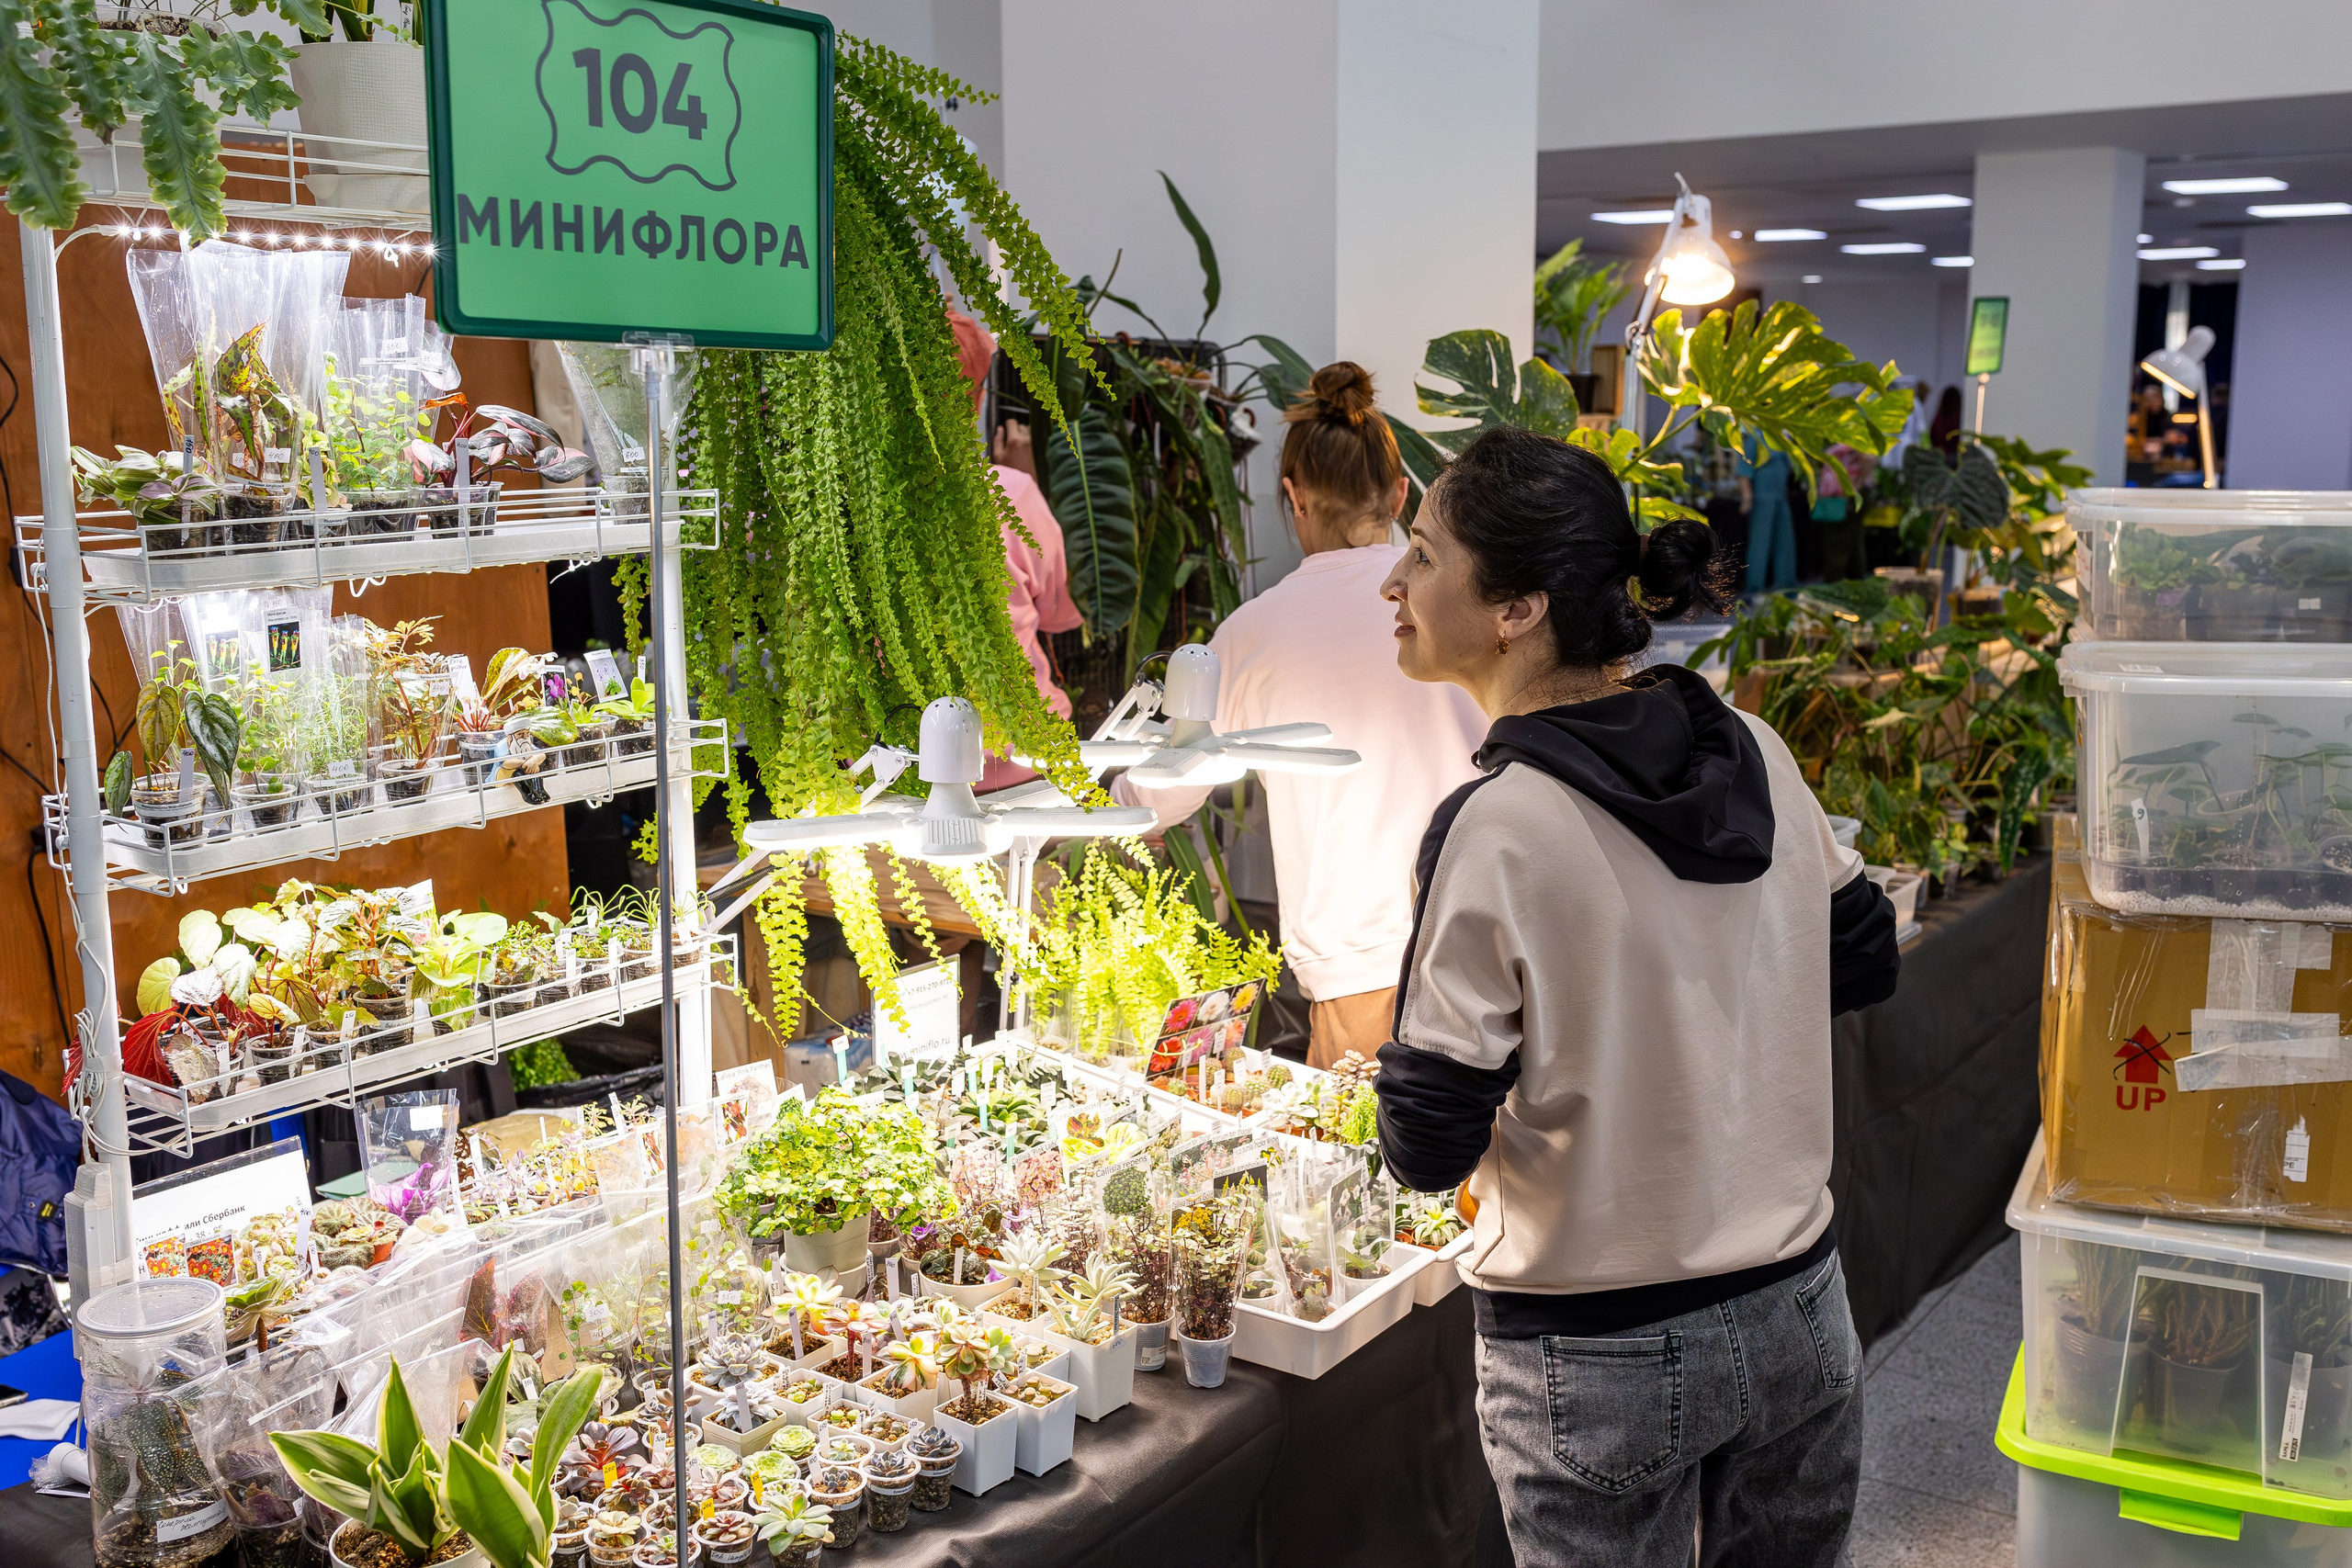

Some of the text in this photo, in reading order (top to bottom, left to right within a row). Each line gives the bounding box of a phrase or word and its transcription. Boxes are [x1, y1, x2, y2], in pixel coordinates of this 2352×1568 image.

[572, 47, 707, 141] 104
[457, 193, 810, 269] МИНИФЛОРА
[332, 764, 349, 773] 400
[2116, 1085, 2166, 1111] UP
[1012, 1153, 1030, 1165] Callisia
[1095, 1164, 1122, 1178] Callisia
[1123, 1156, 1148, 1170] repens
[202, 1205, 245, 1224] Сбербанк
